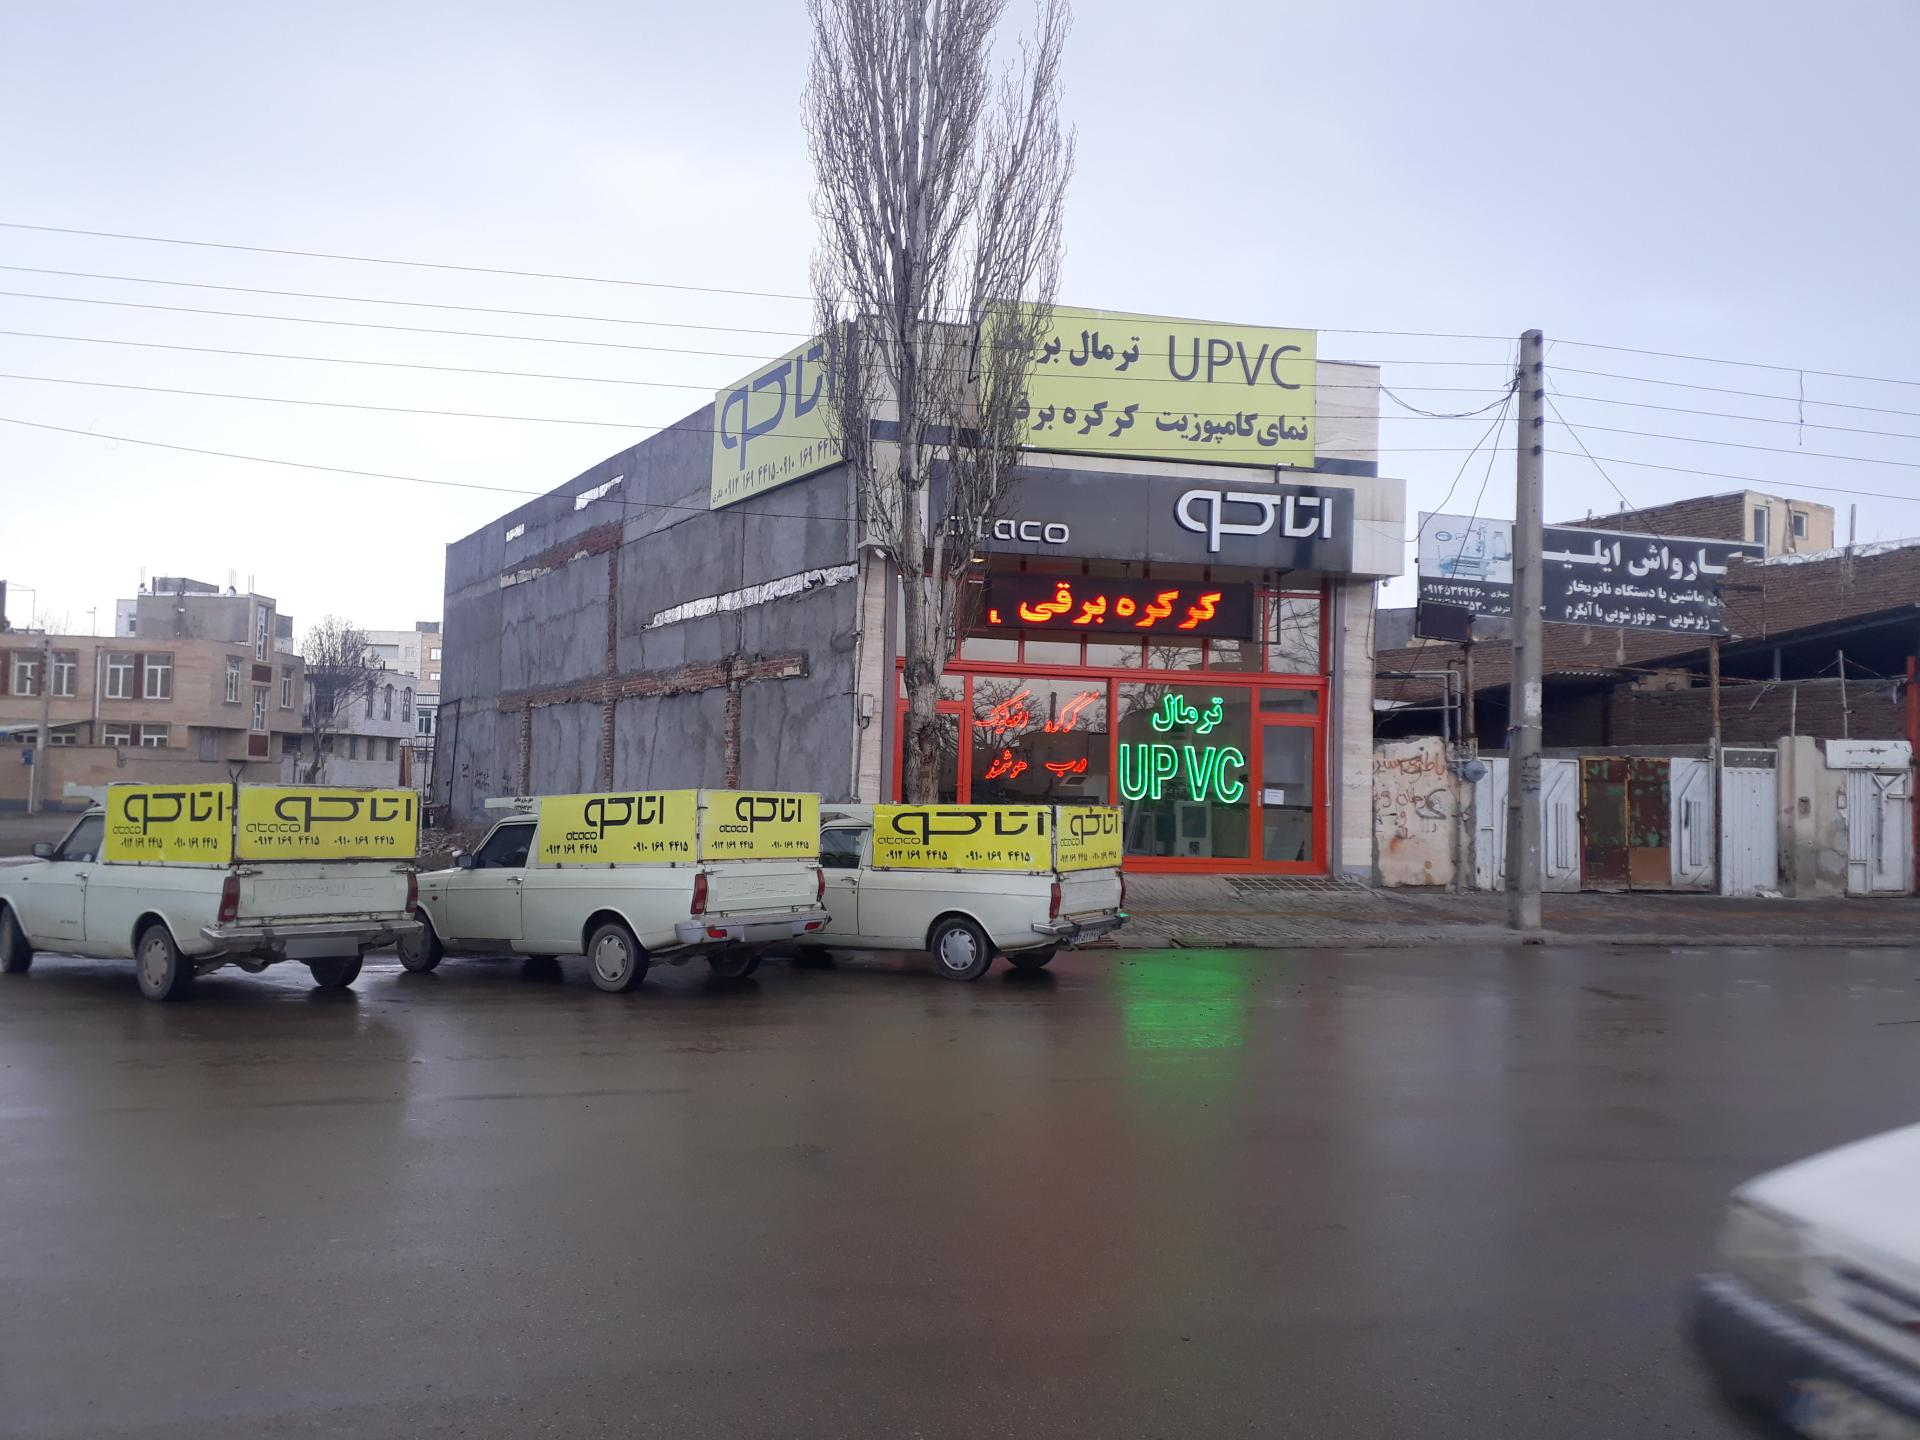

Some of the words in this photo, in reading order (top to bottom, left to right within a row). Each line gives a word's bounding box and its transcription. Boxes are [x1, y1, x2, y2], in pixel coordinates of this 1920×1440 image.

[1069, 329, 1140, 372] ترمال
[1168, 335, 1302, 390] UPVC
[1155, 411, 1258, 444] کامپوزیت
[1256, 414, 1309, 447] نمای
[1627, 543, 1729, 582] ارواش
[1020, 582, 1107, 625] برقی
[1614, 583, 1656, 599] دستگاه
[1658, 586, 1667, 602] با
[1669, 589, 1705, 604] ماشین
[1116, 589, 1222, 629] کرکره
[1595, 602, 1603, 618] با
[1152, 693, 1224, 734] ترمال
[1119, 744, 1245, 804] UPVC
[277, 835, 293, 846] ۱۶۹
[298, 835, 320, 846] ۴۴۱۵
[334, 835, 351, 846] ۰۹۱۰
[355, 835, 369, 846] ۱۶۹
[374, 835, 395, 846] ۴۴۱۵
[906, 850, 921, 861] ۱۶۹
[926, 850, 948, 861] ۴۴۱۵
[965, 850, 983, 861] ۰۹۱۰
[987, 850, 1002, 861] ۱۶۹
[1008, 850, 1031, 862] ۴۴۱۵
